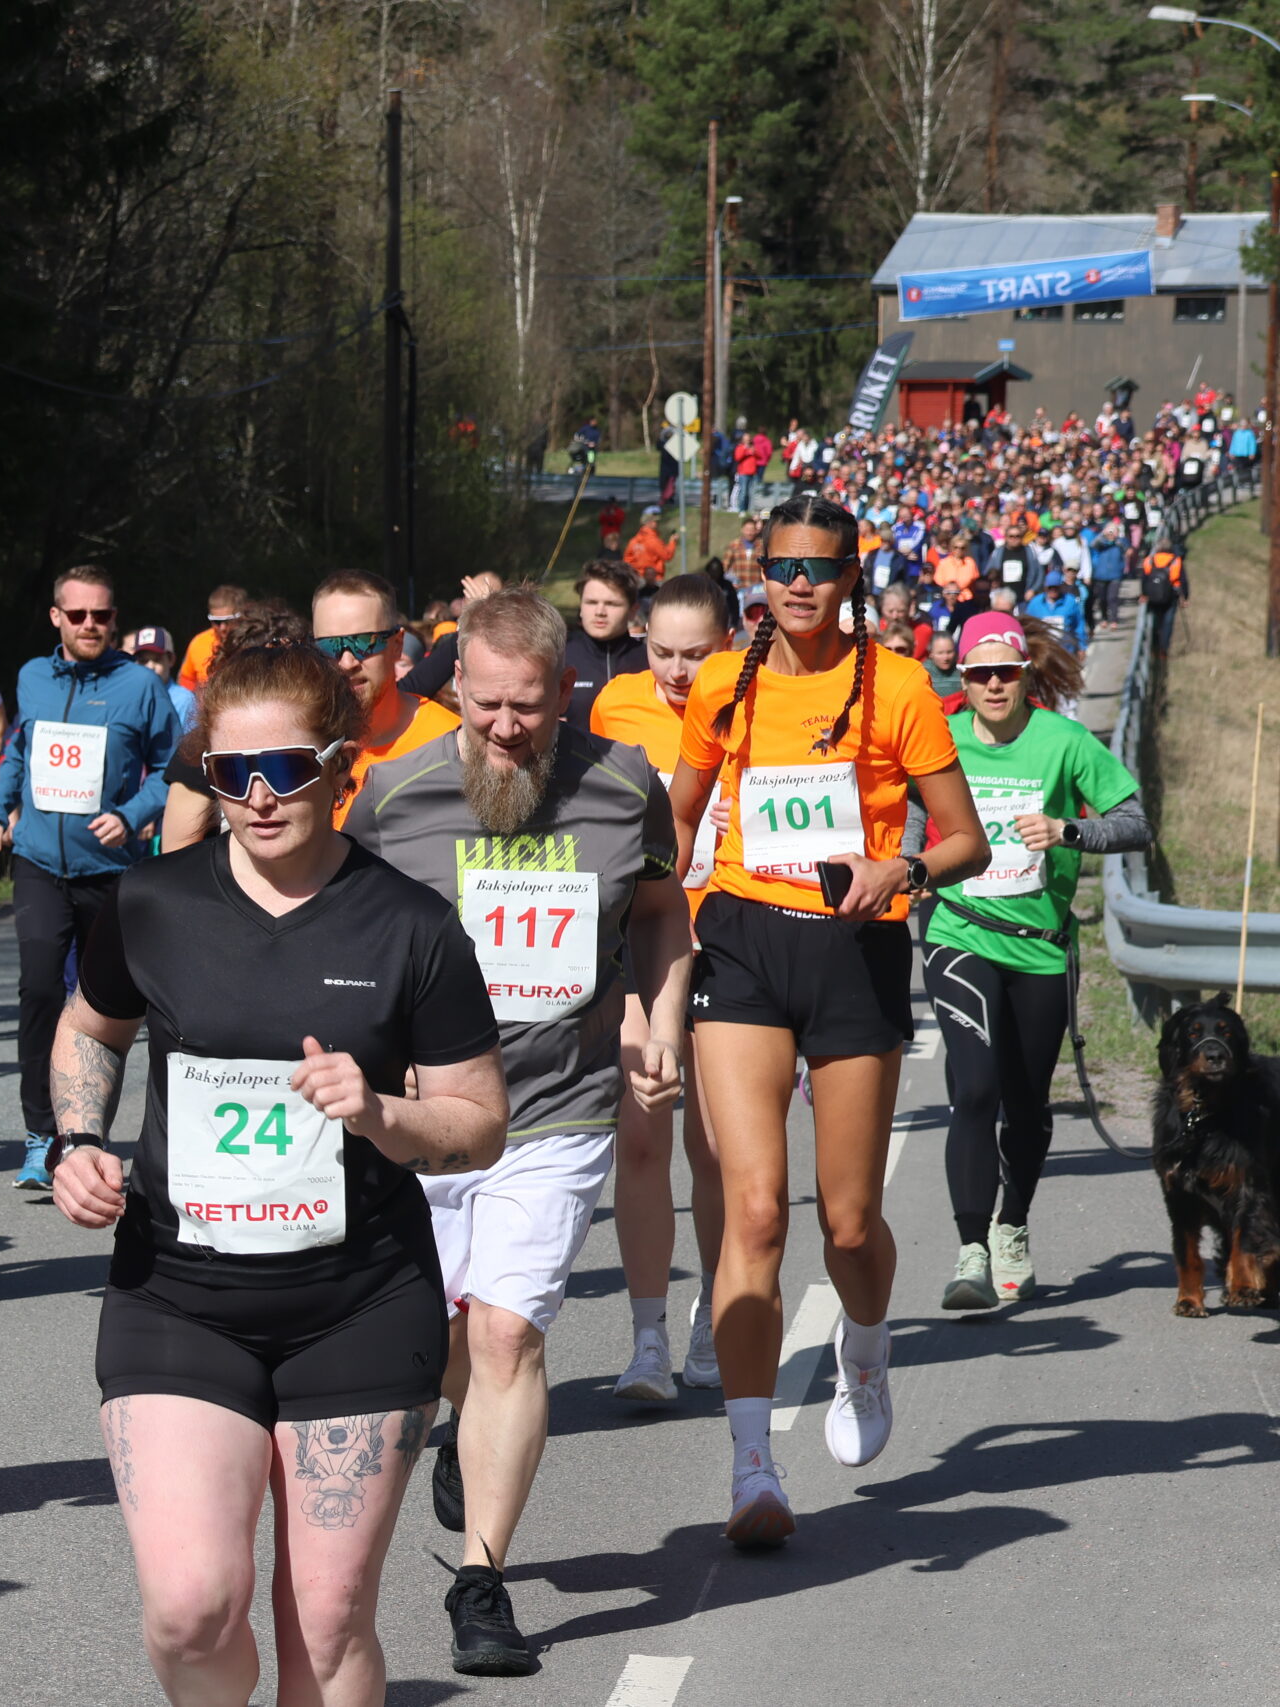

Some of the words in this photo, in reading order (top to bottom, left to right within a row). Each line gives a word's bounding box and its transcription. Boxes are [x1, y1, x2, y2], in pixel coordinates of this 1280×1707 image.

[800, 715, 829, 728] TEAM
[49, 743, 82, 769] 98
[749, 775, 815, 788] Baksjøløpet
[819, 773, 847, 783] 2025
[35, 786, 88, 799] RETURA
[758, 795, 834, 832] 101
[756, 861, 824, 876] RETU
[974, 869, 1031, 880] ETURA
[476, 880, 553, 896] Baksjøløpet
[558, 884, 589, 893] 2025
[485, 906, 575, 948] 117
[487, 983, 571, 999] ETURA
[185, 1066, 280, 1088] Baksjøløpet
[214, 1102, 293, 1156] 24
[185, 1202, 315, 1222] RETURA
